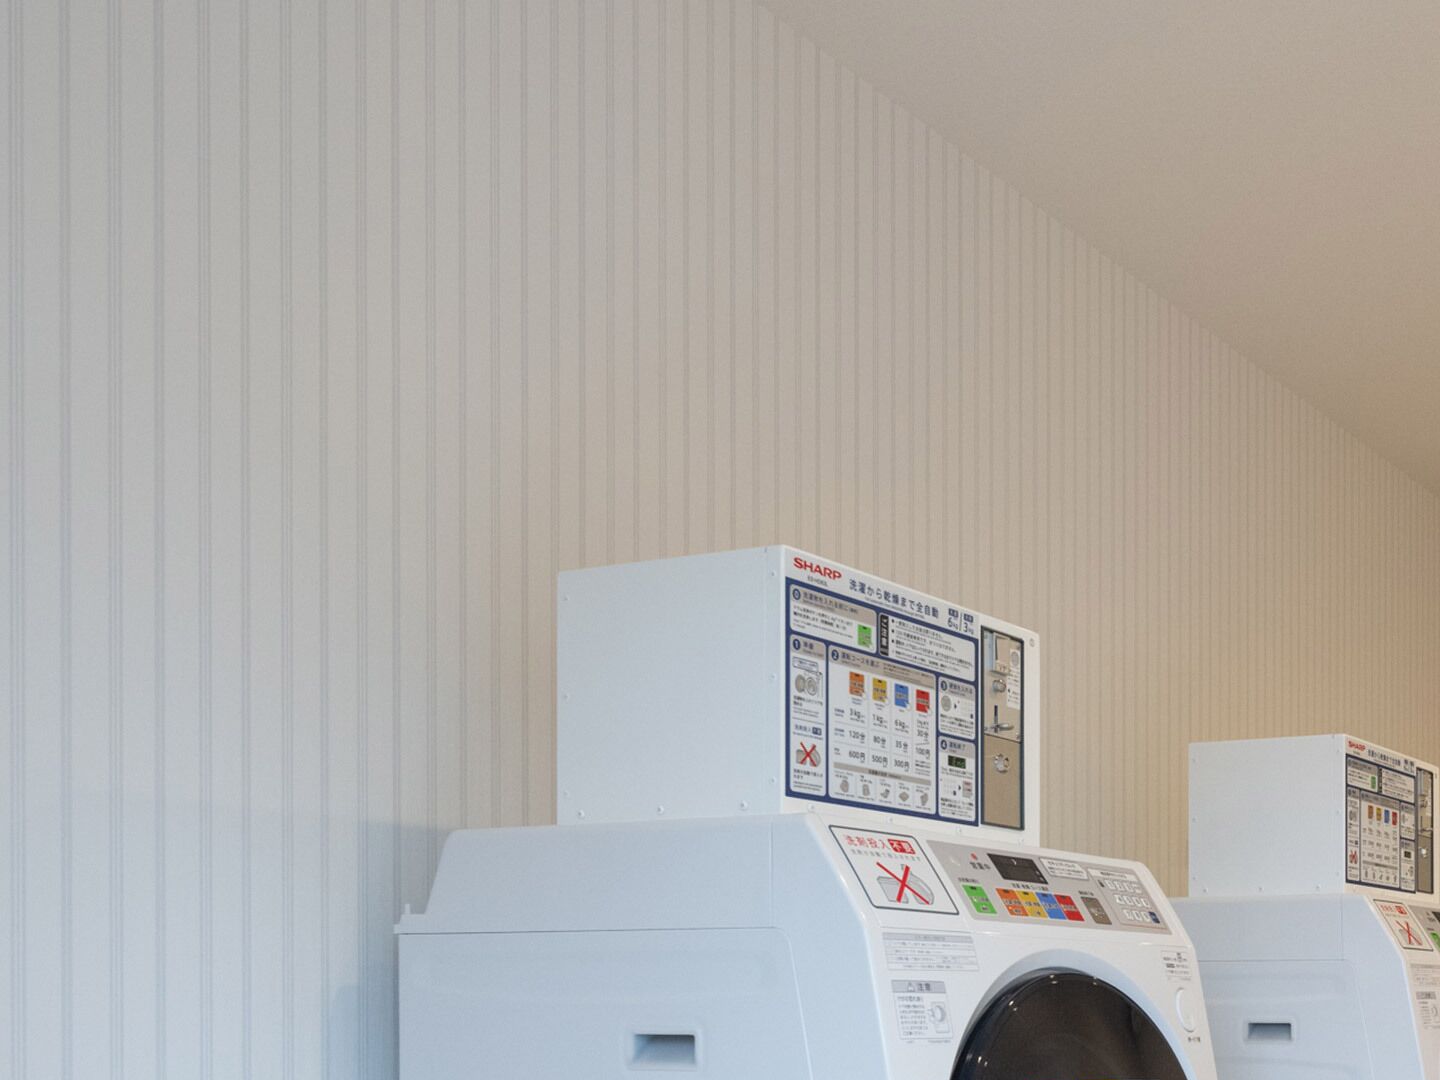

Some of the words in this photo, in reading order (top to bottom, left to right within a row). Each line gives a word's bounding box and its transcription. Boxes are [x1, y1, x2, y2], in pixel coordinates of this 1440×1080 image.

[793, 557, 842, 580] SHARP
[849, 578, 939, 619] 洗濯から乾燥まで全自動
[1348, 741, 1366, 751] SHARP
